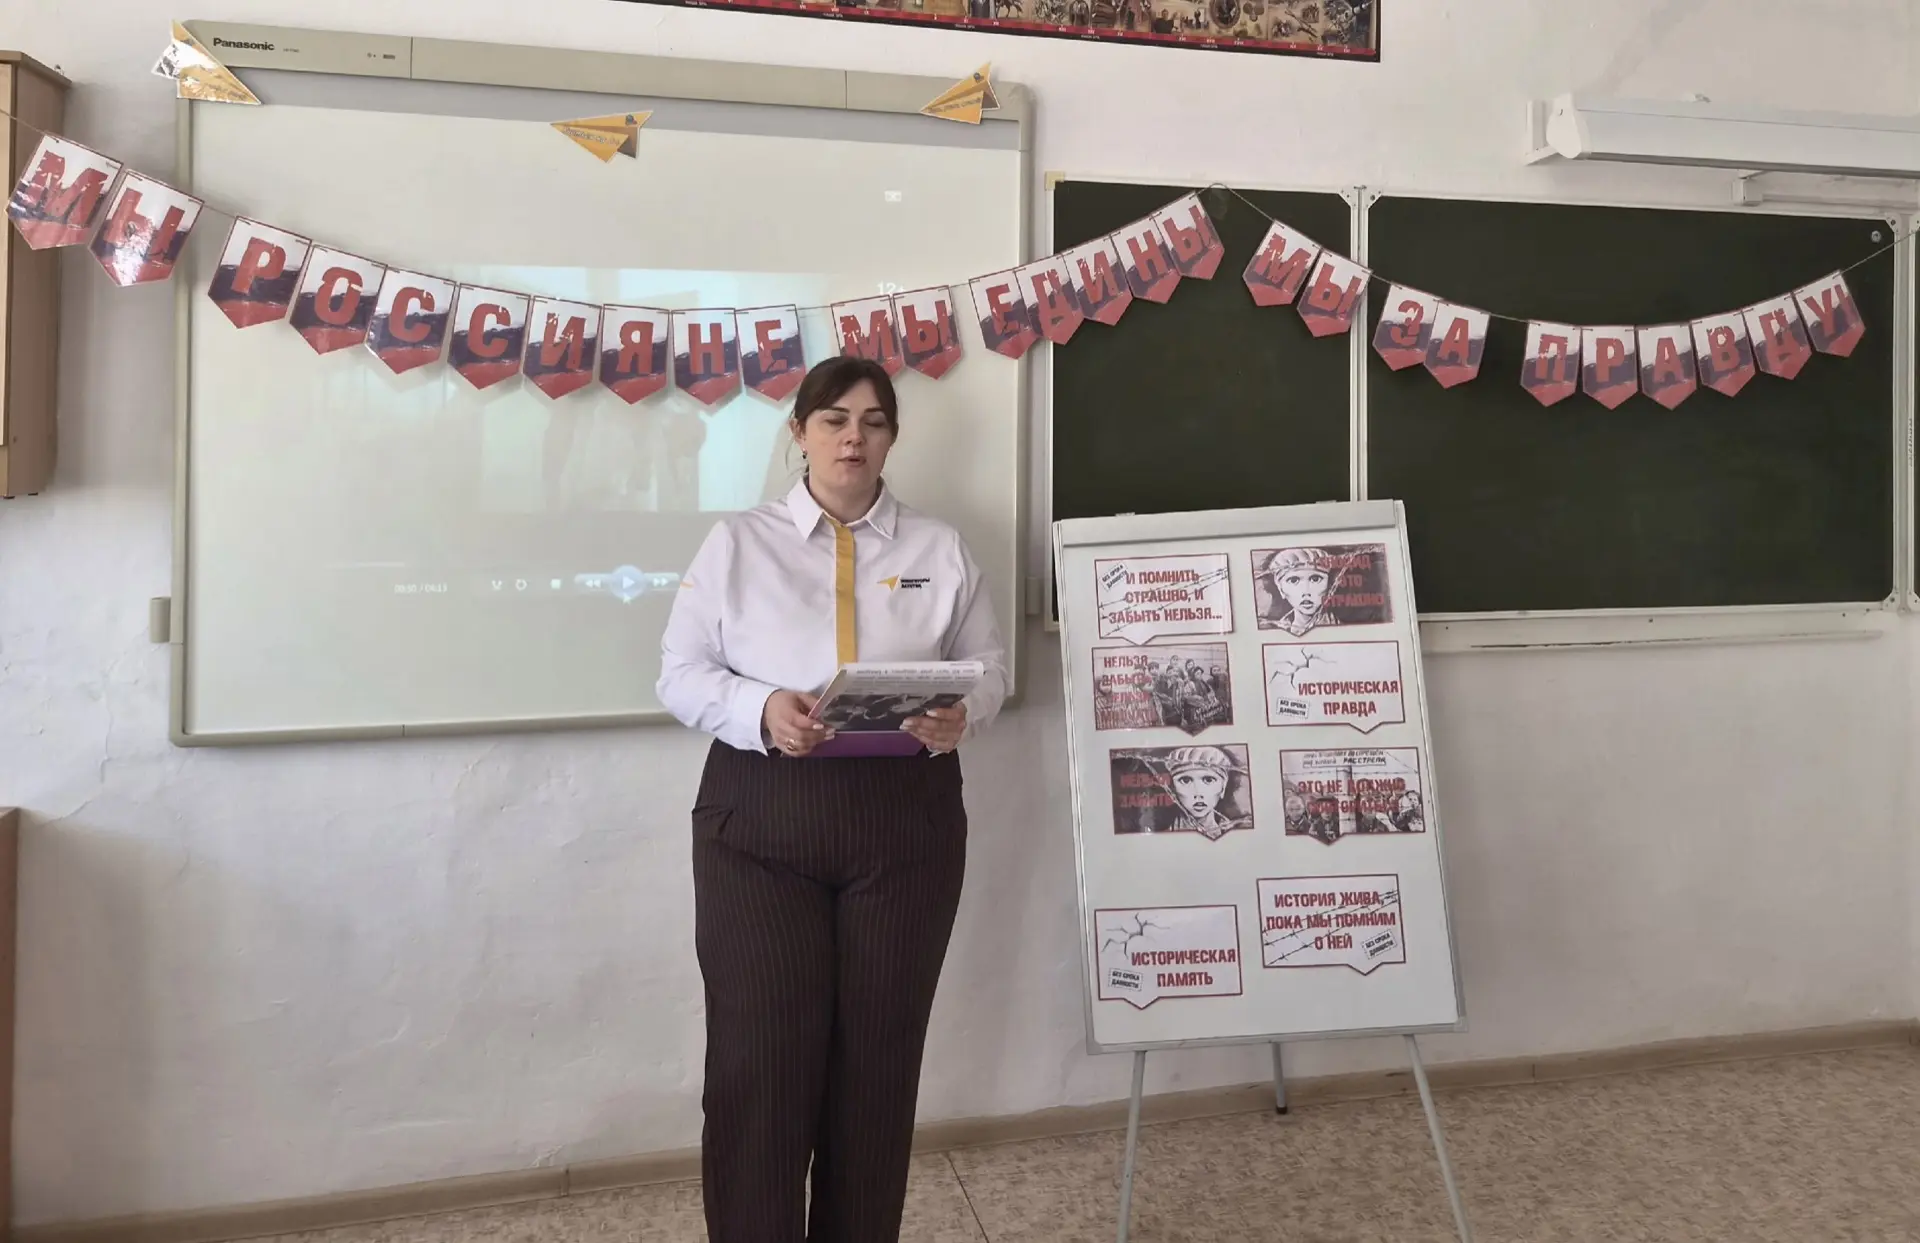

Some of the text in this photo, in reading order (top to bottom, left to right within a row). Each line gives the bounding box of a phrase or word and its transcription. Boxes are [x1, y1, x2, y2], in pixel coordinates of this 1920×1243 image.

[213, 37, 275, 51] Panasonic
[26, 150, 1213, 375] МЫ РОССИЯНЕ МЫ ЕДИНЫ
[1252, 232, 1363, 314] МЫ
[1390, 300, 1470, 367] ЗА
[1126, 570, 1200, 585] И ПОМНИТЬ
[1125, 588, 1204, 604] СТРАШНО, И
[1109, 609, 1161, 624] ЗАБЫТЬ
[1103, 655, 1148, 669] НЕЛЬЗЯ
[1298, 680, 1399, 695] ИСТОРИЧЕСКАЯ
[1323, 701, 1377, 717] ПРАВДА
[1327, 779, 1342, 793] НЕ
[1274, 892, 1336, 908] ИСТОРИЯ
[1266, 912, 1396, 930] ПОКА МЫ ПОМНИМ
[1315, 933, 1353, 950] О НЕЙ
[1131, 949, 1236, 966] ИСТОРИЧЕСКАЯ
[1157, 972, 1214, 987] ПАМЯТЬ
